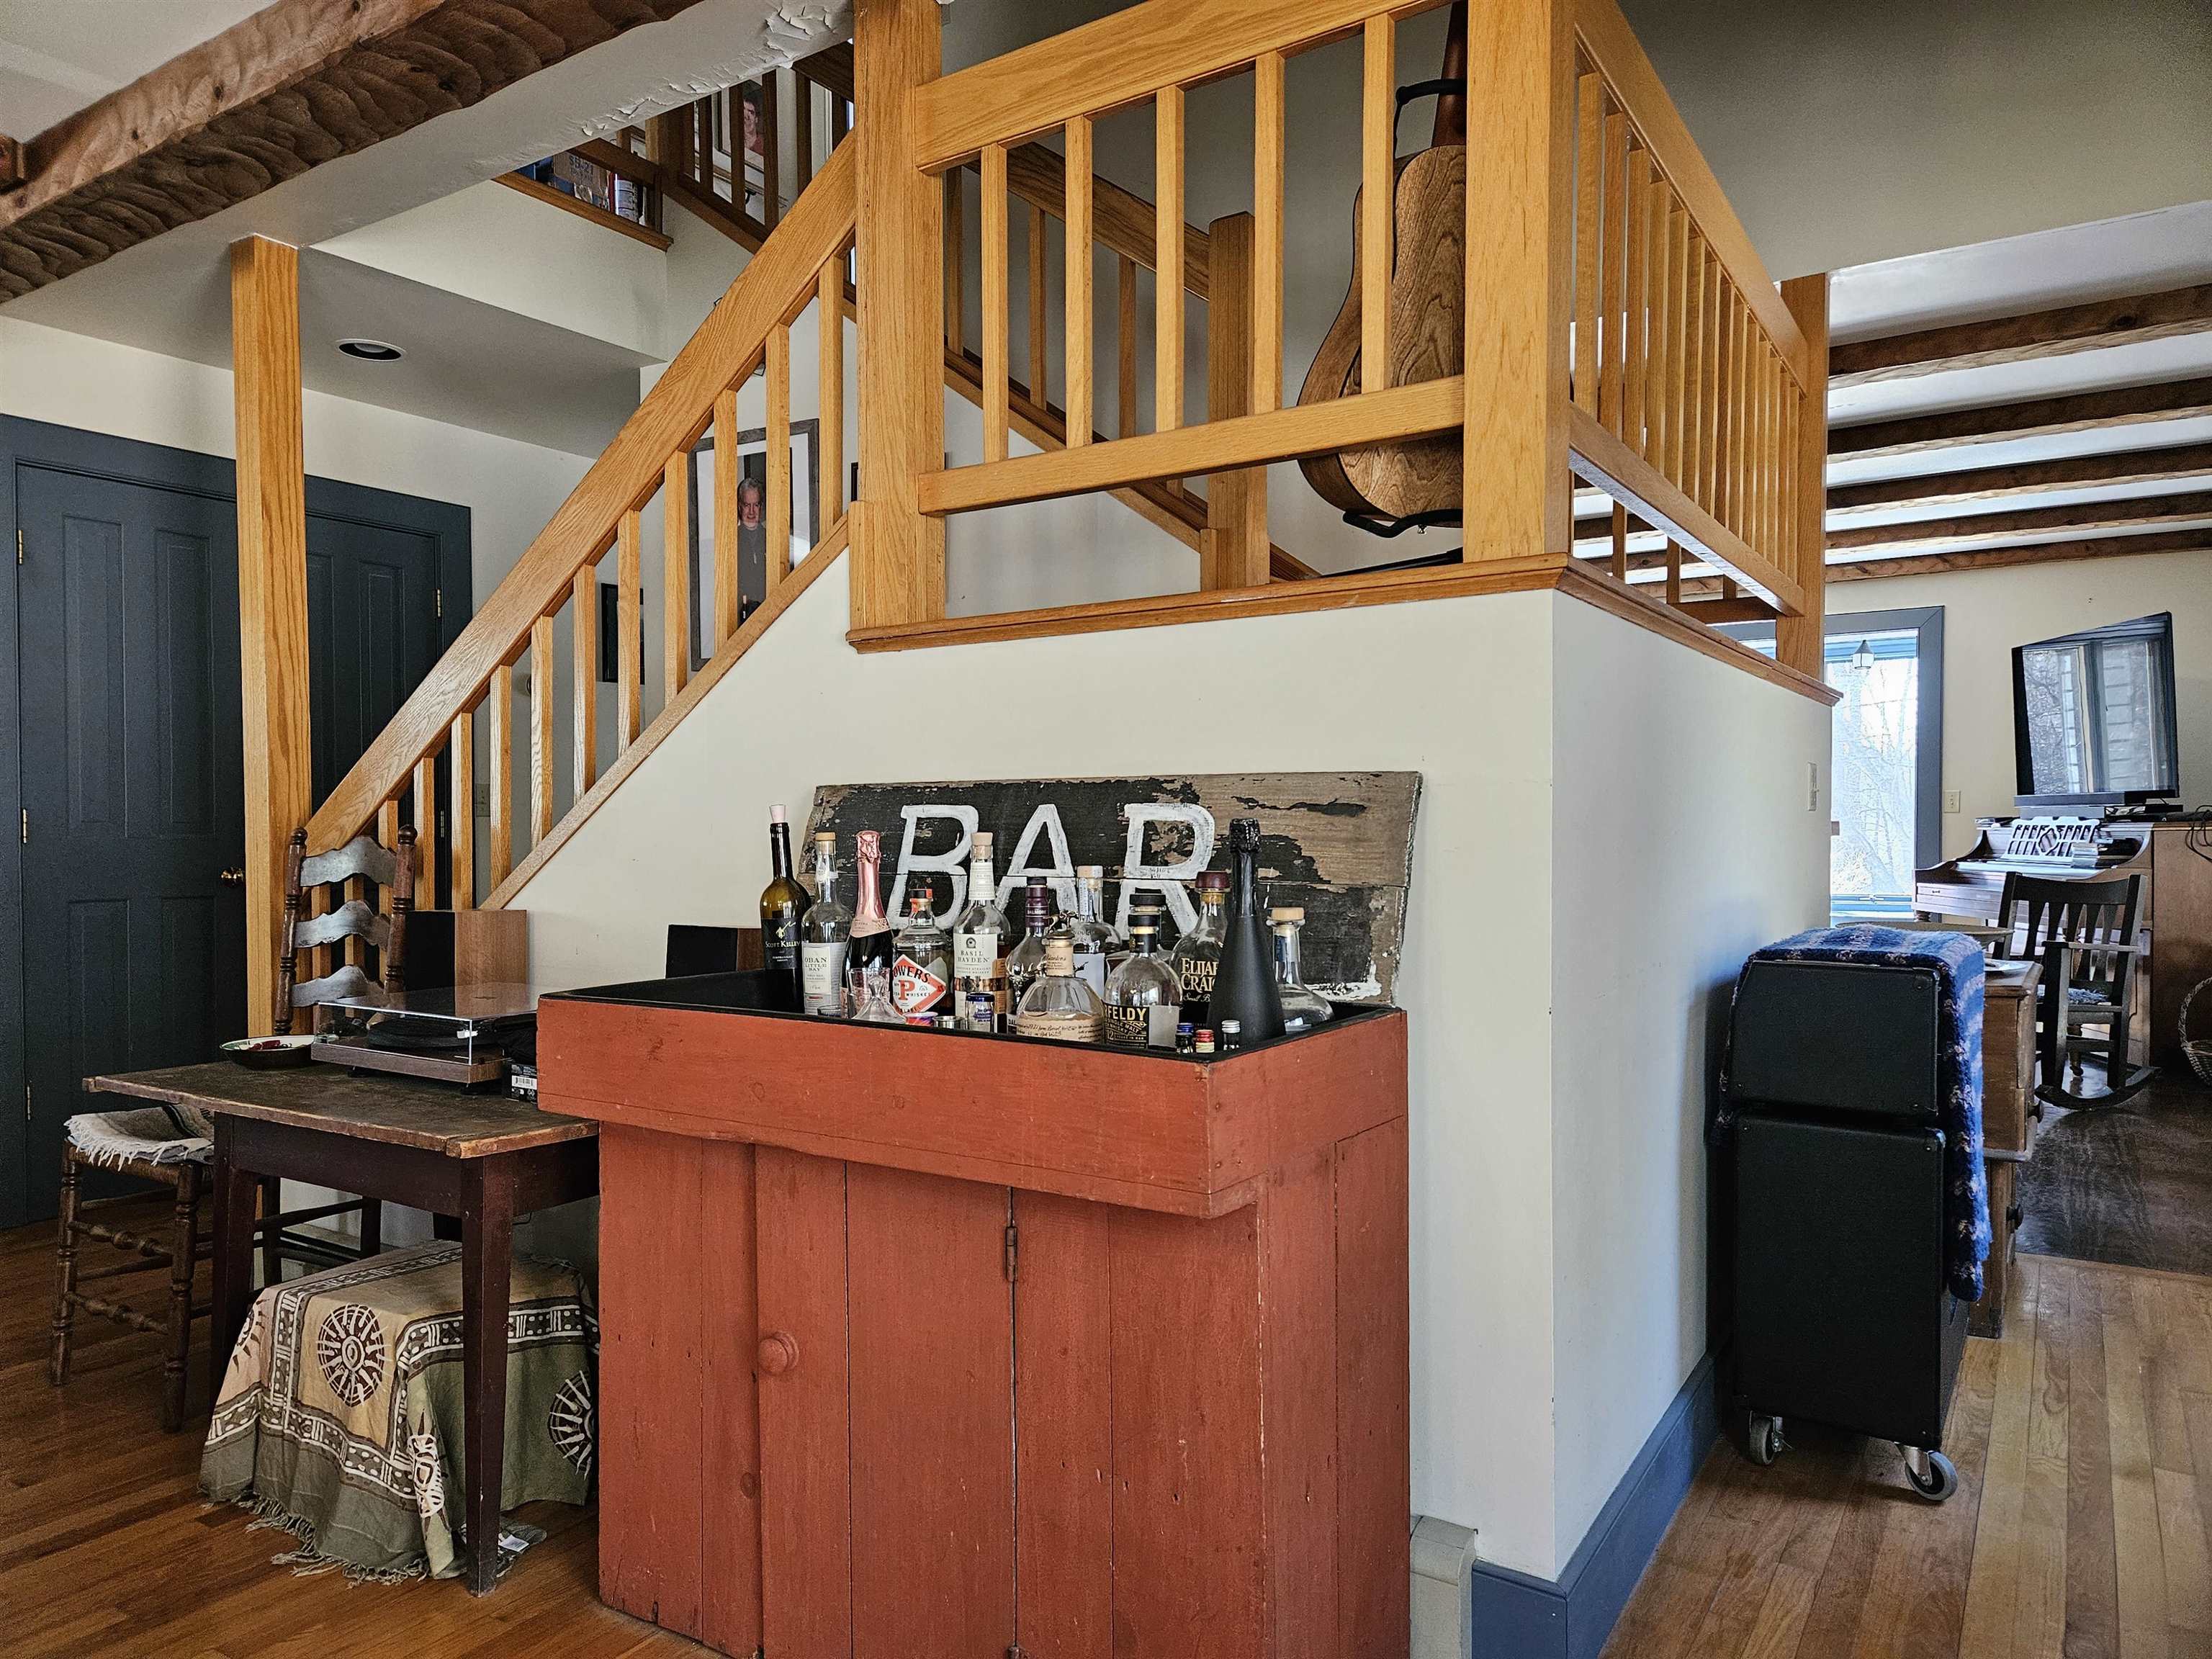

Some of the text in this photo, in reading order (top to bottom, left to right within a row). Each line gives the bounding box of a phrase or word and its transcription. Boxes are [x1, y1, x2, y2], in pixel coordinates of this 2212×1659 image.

[886, 803, 1215, 933] BAR
[898, 980, 915, 1000] P
[1183, 993, 1201, 1002] Small
[1125, 1024, 1139, 1033] MALT
